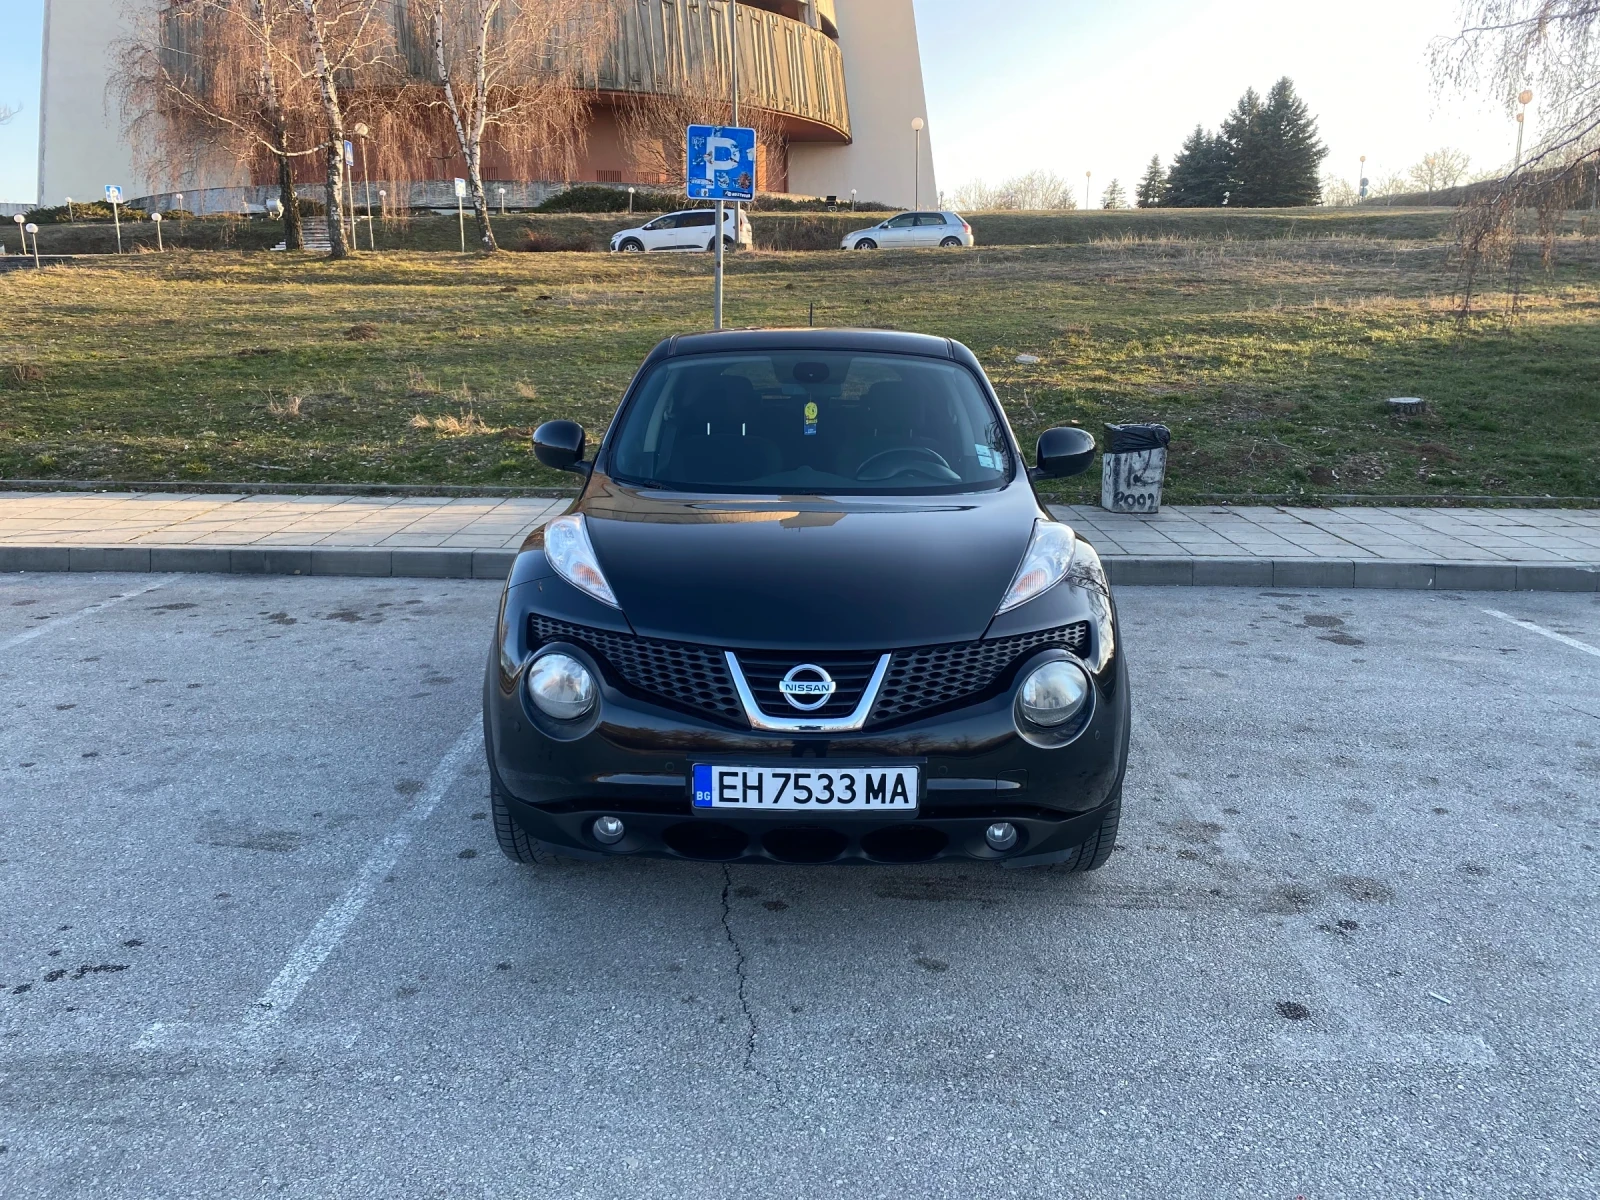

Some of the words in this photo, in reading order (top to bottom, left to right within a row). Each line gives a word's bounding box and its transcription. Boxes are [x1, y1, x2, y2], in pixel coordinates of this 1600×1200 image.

[706, 137, 740, 189] P
[785, 683, 830, 692] NISSAN
[696, 791, 711, 801] BG
[718, 771, 764, 804] EH
[771, 773, 857, 805] 7533
[865, 773, 909, 805] MA
